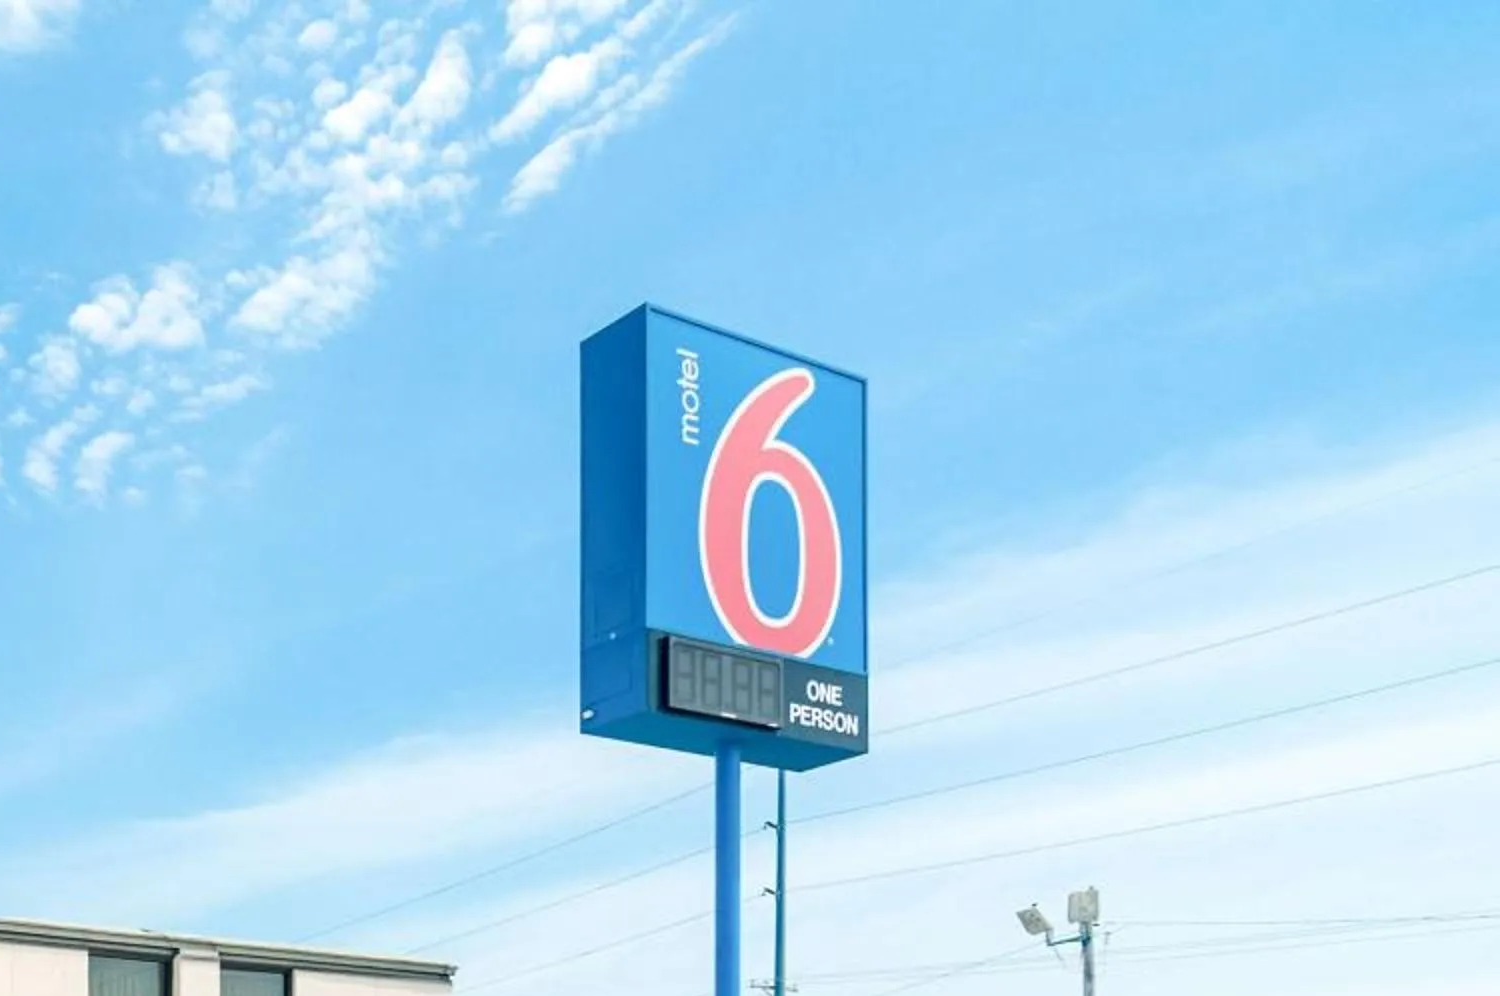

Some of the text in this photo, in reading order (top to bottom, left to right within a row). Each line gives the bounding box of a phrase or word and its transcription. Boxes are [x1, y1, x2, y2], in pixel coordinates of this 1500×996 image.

[676, 348, 842, 659] motel 6
[807, 680, 843, 706] ONE
[788, 702, 859, 736] PERSON
